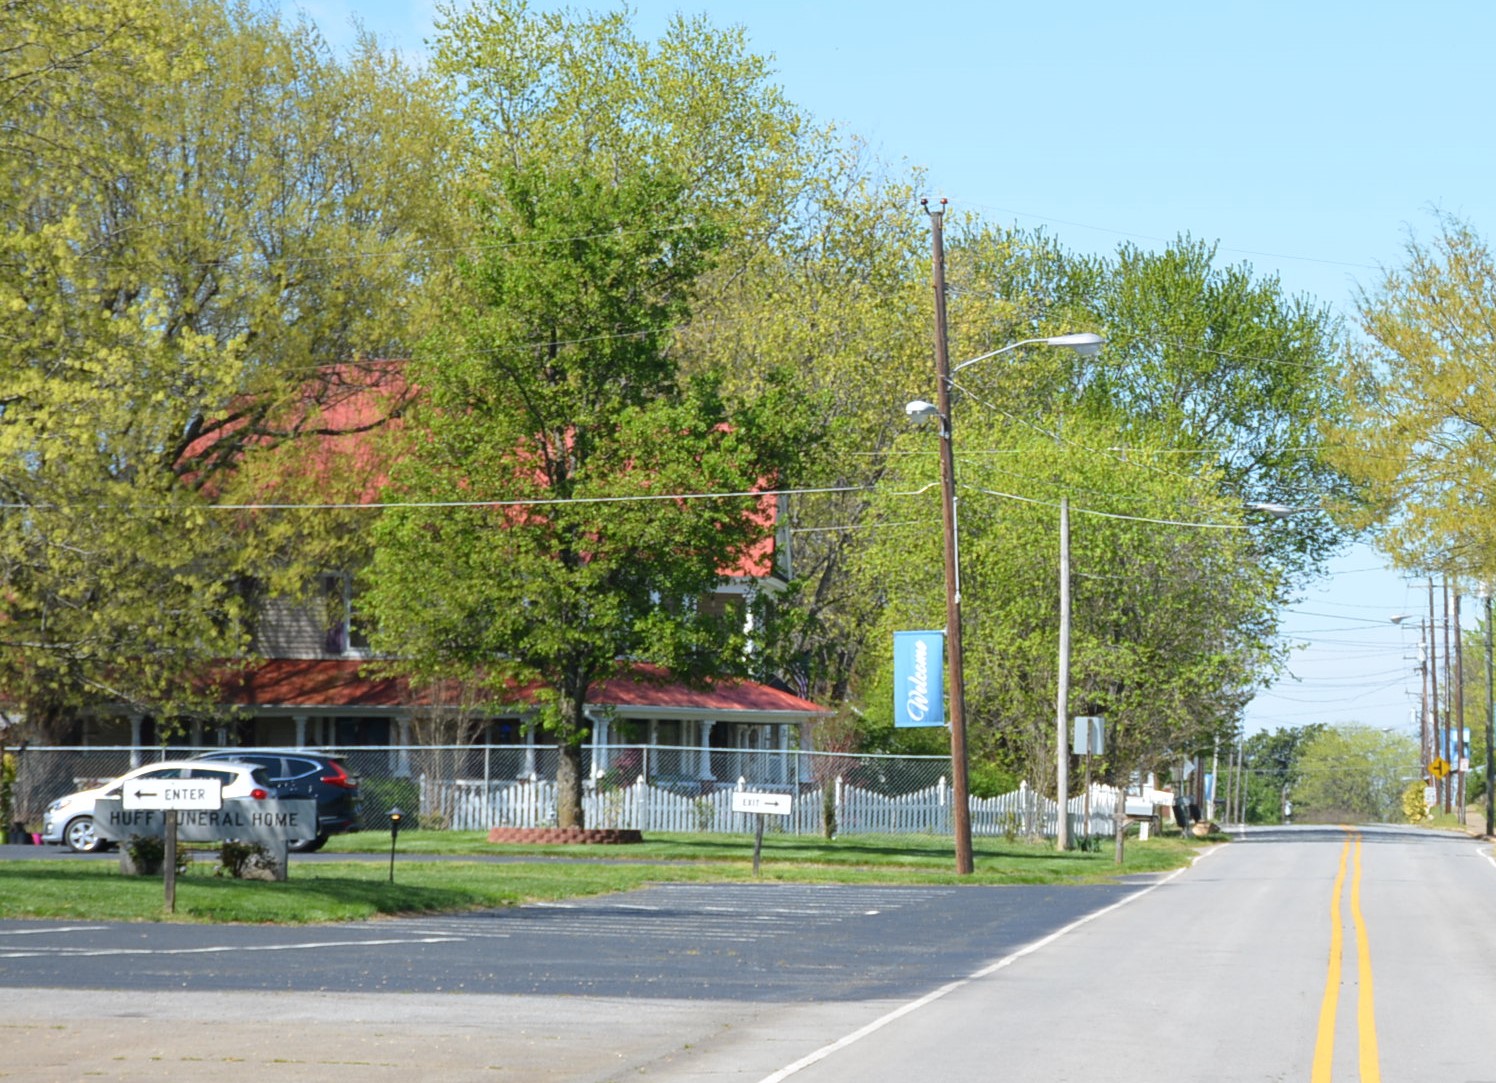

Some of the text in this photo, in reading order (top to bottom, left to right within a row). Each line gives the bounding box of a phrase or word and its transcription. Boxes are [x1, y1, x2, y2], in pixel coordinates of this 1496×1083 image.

[907, 640, 928, 721] Welcome
[165, 789, 205, 800] ENTER
[743, 799, 760, 807] EXIT
[110, 811, 154, 825] HUFF
[252, 813, 298, 826] HOME
